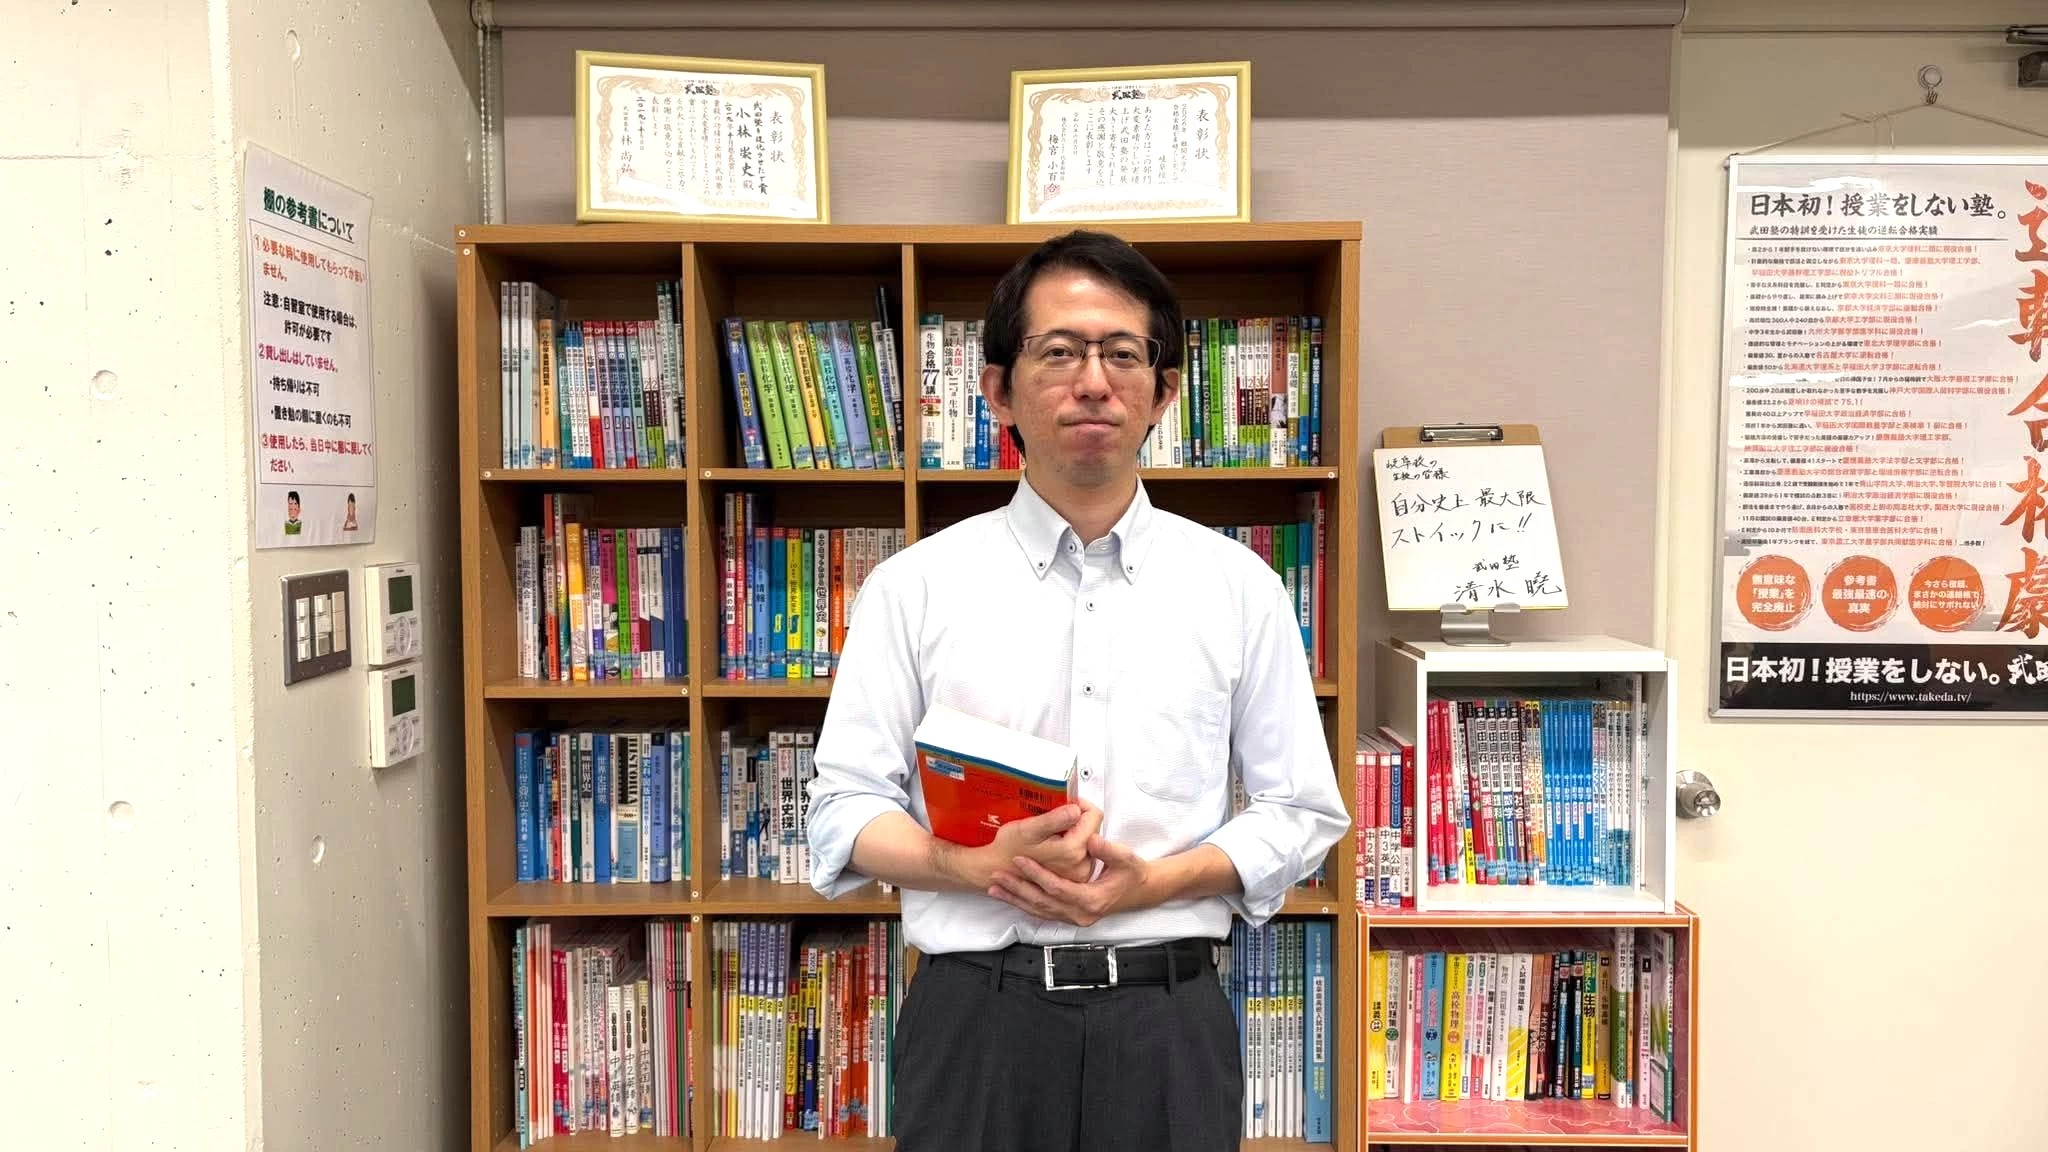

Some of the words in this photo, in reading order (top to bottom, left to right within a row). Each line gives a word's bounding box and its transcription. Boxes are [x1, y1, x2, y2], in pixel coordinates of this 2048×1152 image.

[770, 110, 785, 163] 表彰状
[1195, 108, 1210, 160] 表彰状
[263, 186, 355, 241] 棚の参考書について
[1750, 193, 2006, 220] 日本初！授業をしない塾。
[1749, 225, 1938, 236] 武田塾の特訓を受けた生徒の逆転合格実績
[263, 262, 288, 283] ません。
[284, 319, 333, 343] 許可が必要です
[270, 458, 294, 473] ださい。
[1391, 492, 1470, 517] 自分史上
[1474, 487, 1547, 508] 最大限
[1472, 553, 1521, 573] 武田塾
[592, 566, 601, 600] 化学基礎
[1453, 579, 1517, 603] 清水
[1752, 574, 1796, 586] 無意味な
[1844, 575, 1877, 586] 参考書
[1832, 588, 1888, 600] 最強最速の
[1912, 600, 1980, 610] 絶対にサボれない
[1752, 602, 1795, 613] 完全廃止
[1847, 603, 1870, 614] 真実
[1726, 656, 2001, 685] 日本初！授業をしない。
[1850, 691, 1972, 704] https://www.takeda.tv/
[1390, 830, 1401, 876] 中学公民
[1450, 990, 1460, 1029] 高校物理
[1584, 994, 1596, 1017] 生物
